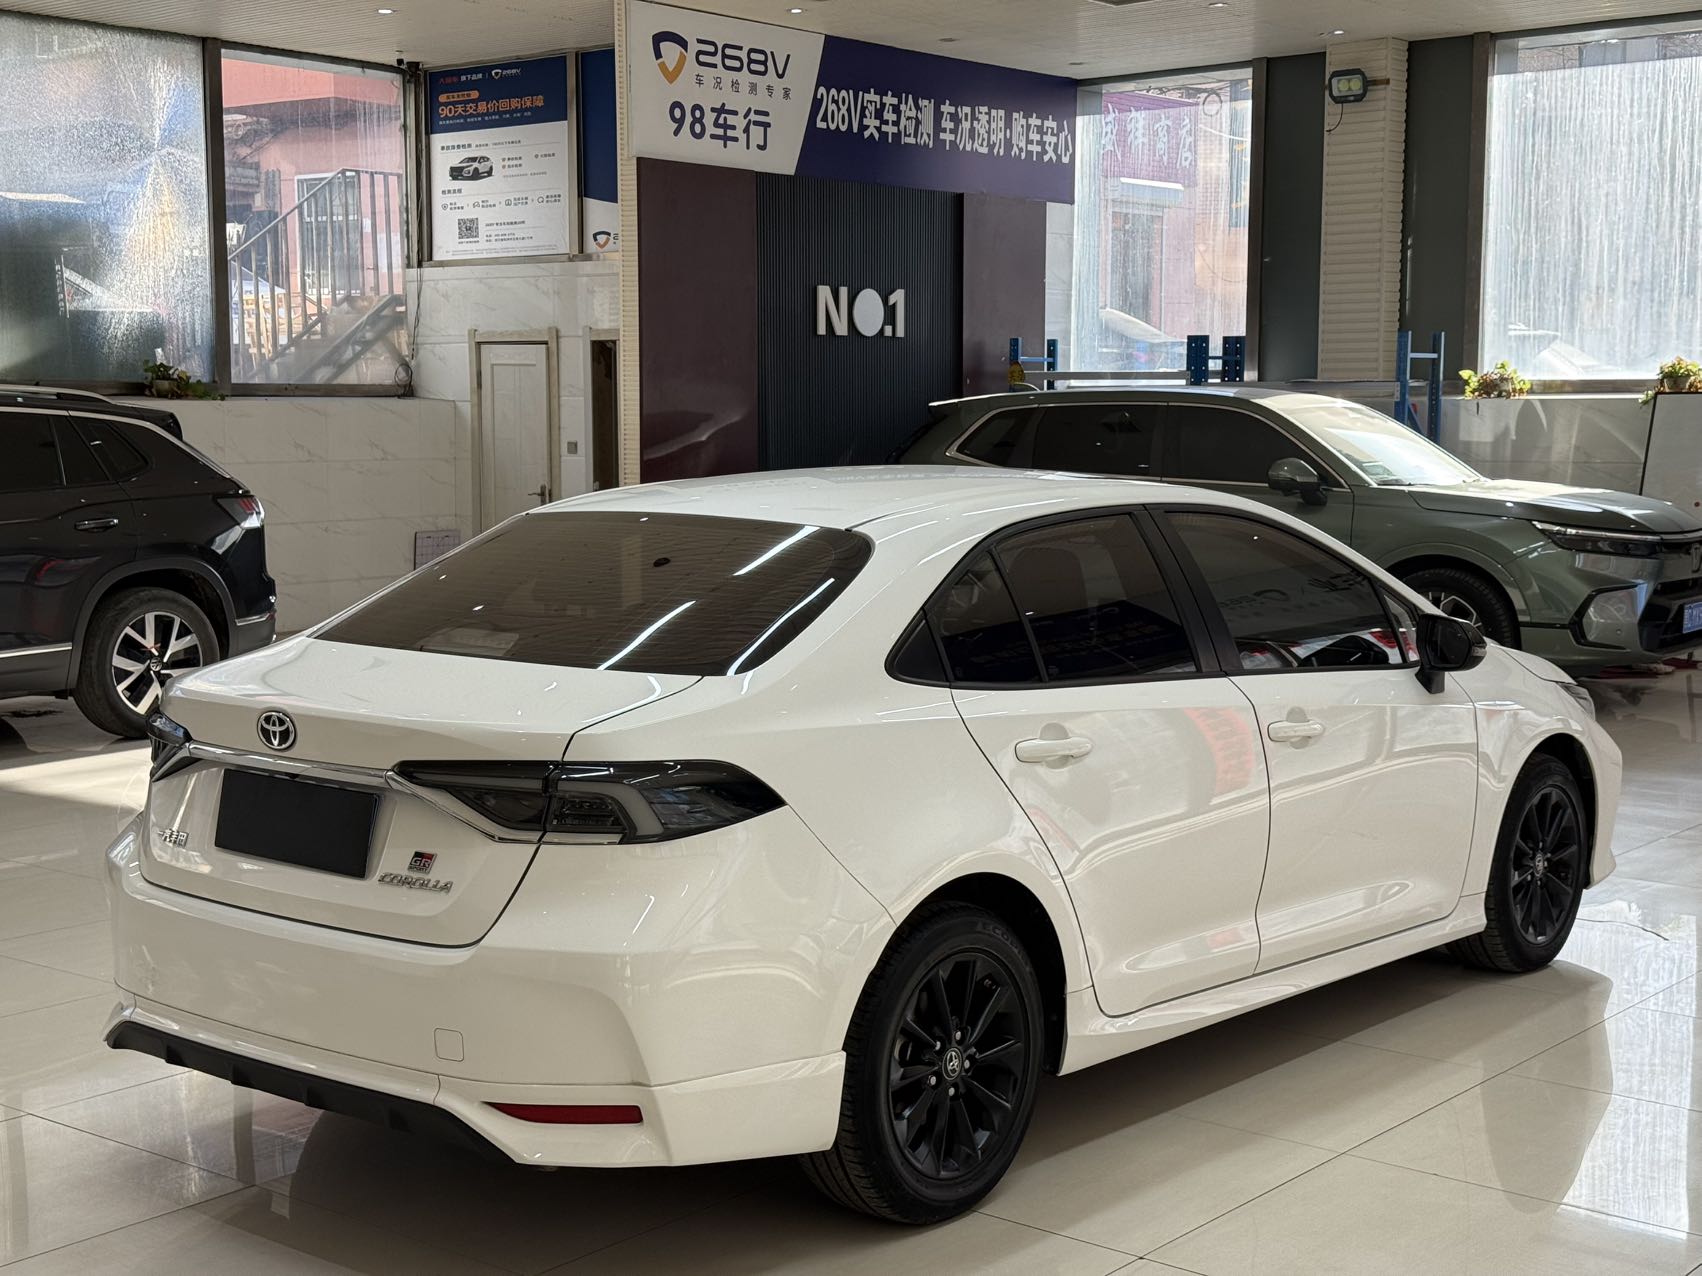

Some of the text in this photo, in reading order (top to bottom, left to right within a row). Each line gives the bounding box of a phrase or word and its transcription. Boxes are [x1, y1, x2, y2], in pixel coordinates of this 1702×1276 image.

[694, 37, 791, 80] 268V
[694, 72, 792, 101] 车况检测专家
[438, 95, 545, 118] 90天交易价回购保障
[667, 99, 772, 152] 98车行
[815, 86, 1073, 165] 268V实车检测 车况透明·购车安心
[816, 285, 905, 337] NO.1
[408, 865, 428, 873] SPORT
[411, 857, 431, 868] GR
[378, 872, 454, 894] COROLLA
